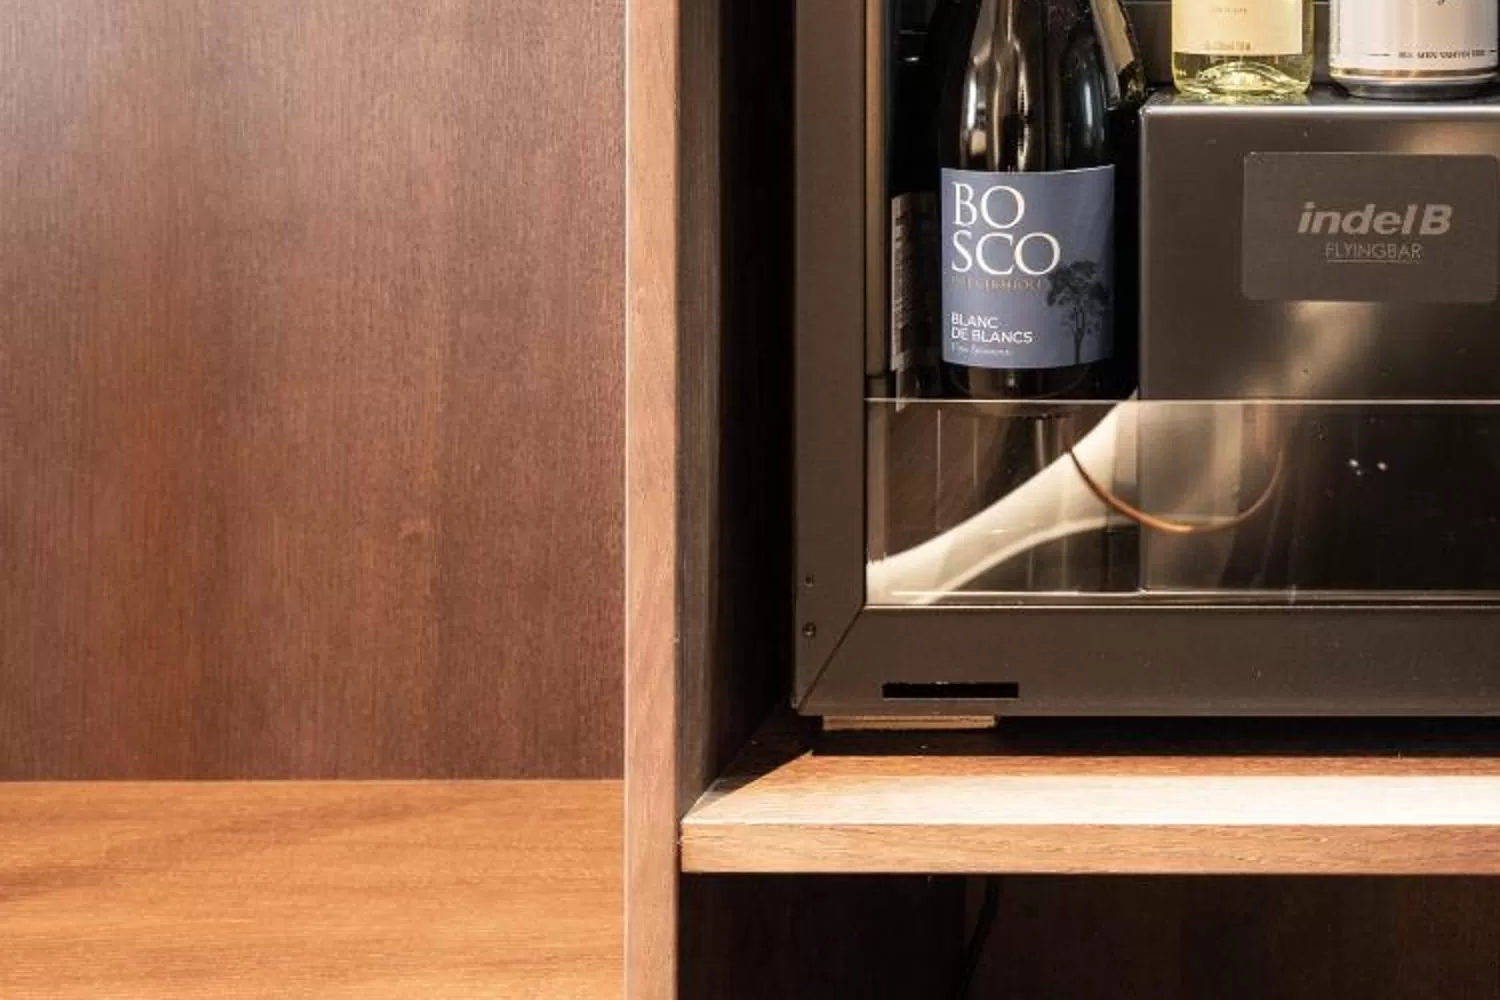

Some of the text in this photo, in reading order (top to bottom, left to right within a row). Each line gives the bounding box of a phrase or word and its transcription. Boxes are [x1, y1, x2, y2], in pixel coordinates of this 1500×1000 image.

[951, 181, 1025, 229] BO
[951, 229, 1061, 275] SCO
[1325, 243, 1423, 259] FLYINGBAR
[951, 311, 999, 329] BLANC
[951, 326, 1033, 344] DE BLANCS
